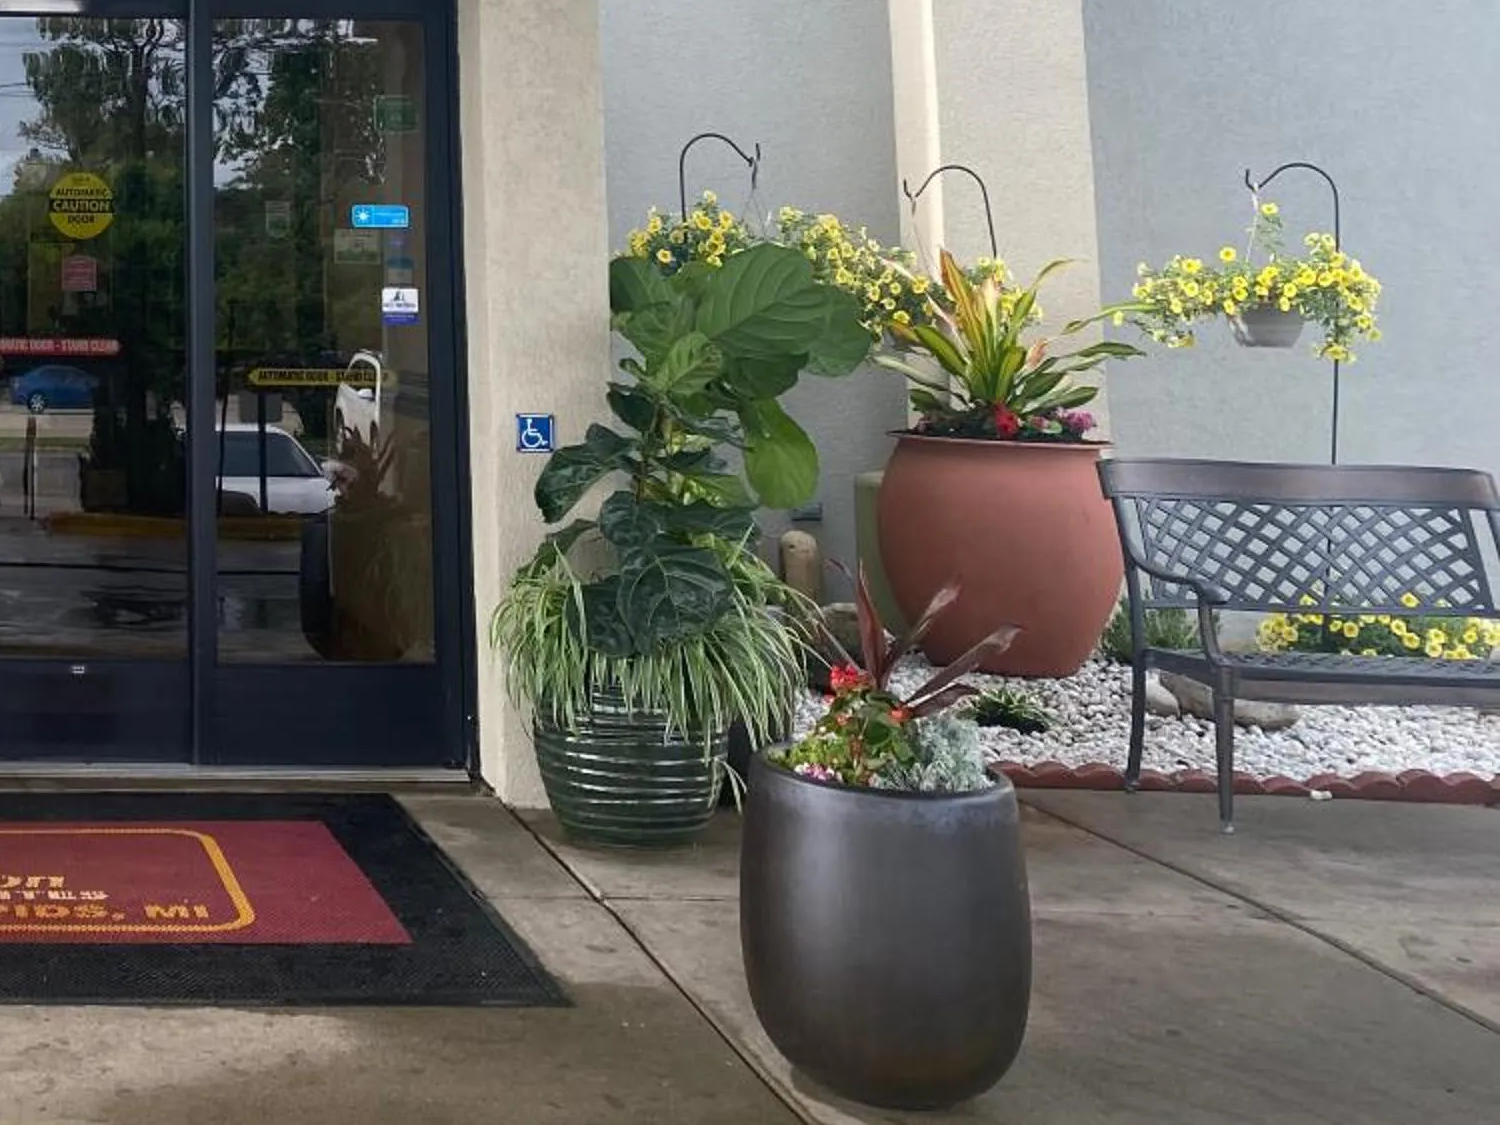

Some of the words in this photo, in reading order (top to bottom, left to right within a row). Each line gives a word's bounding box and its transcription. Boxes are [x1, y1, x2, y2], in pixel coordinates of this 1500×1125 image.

[56, 187, 108, 196] AUTOMATIC
[52, 200, 110, 212] CAUTION
[67, 215, 97, 224] DOOR
[258, 370, 304, 381] AUTOMATIC
[306, 370, 328, 381] DOOR
[145, 904, 209, 919] MI
